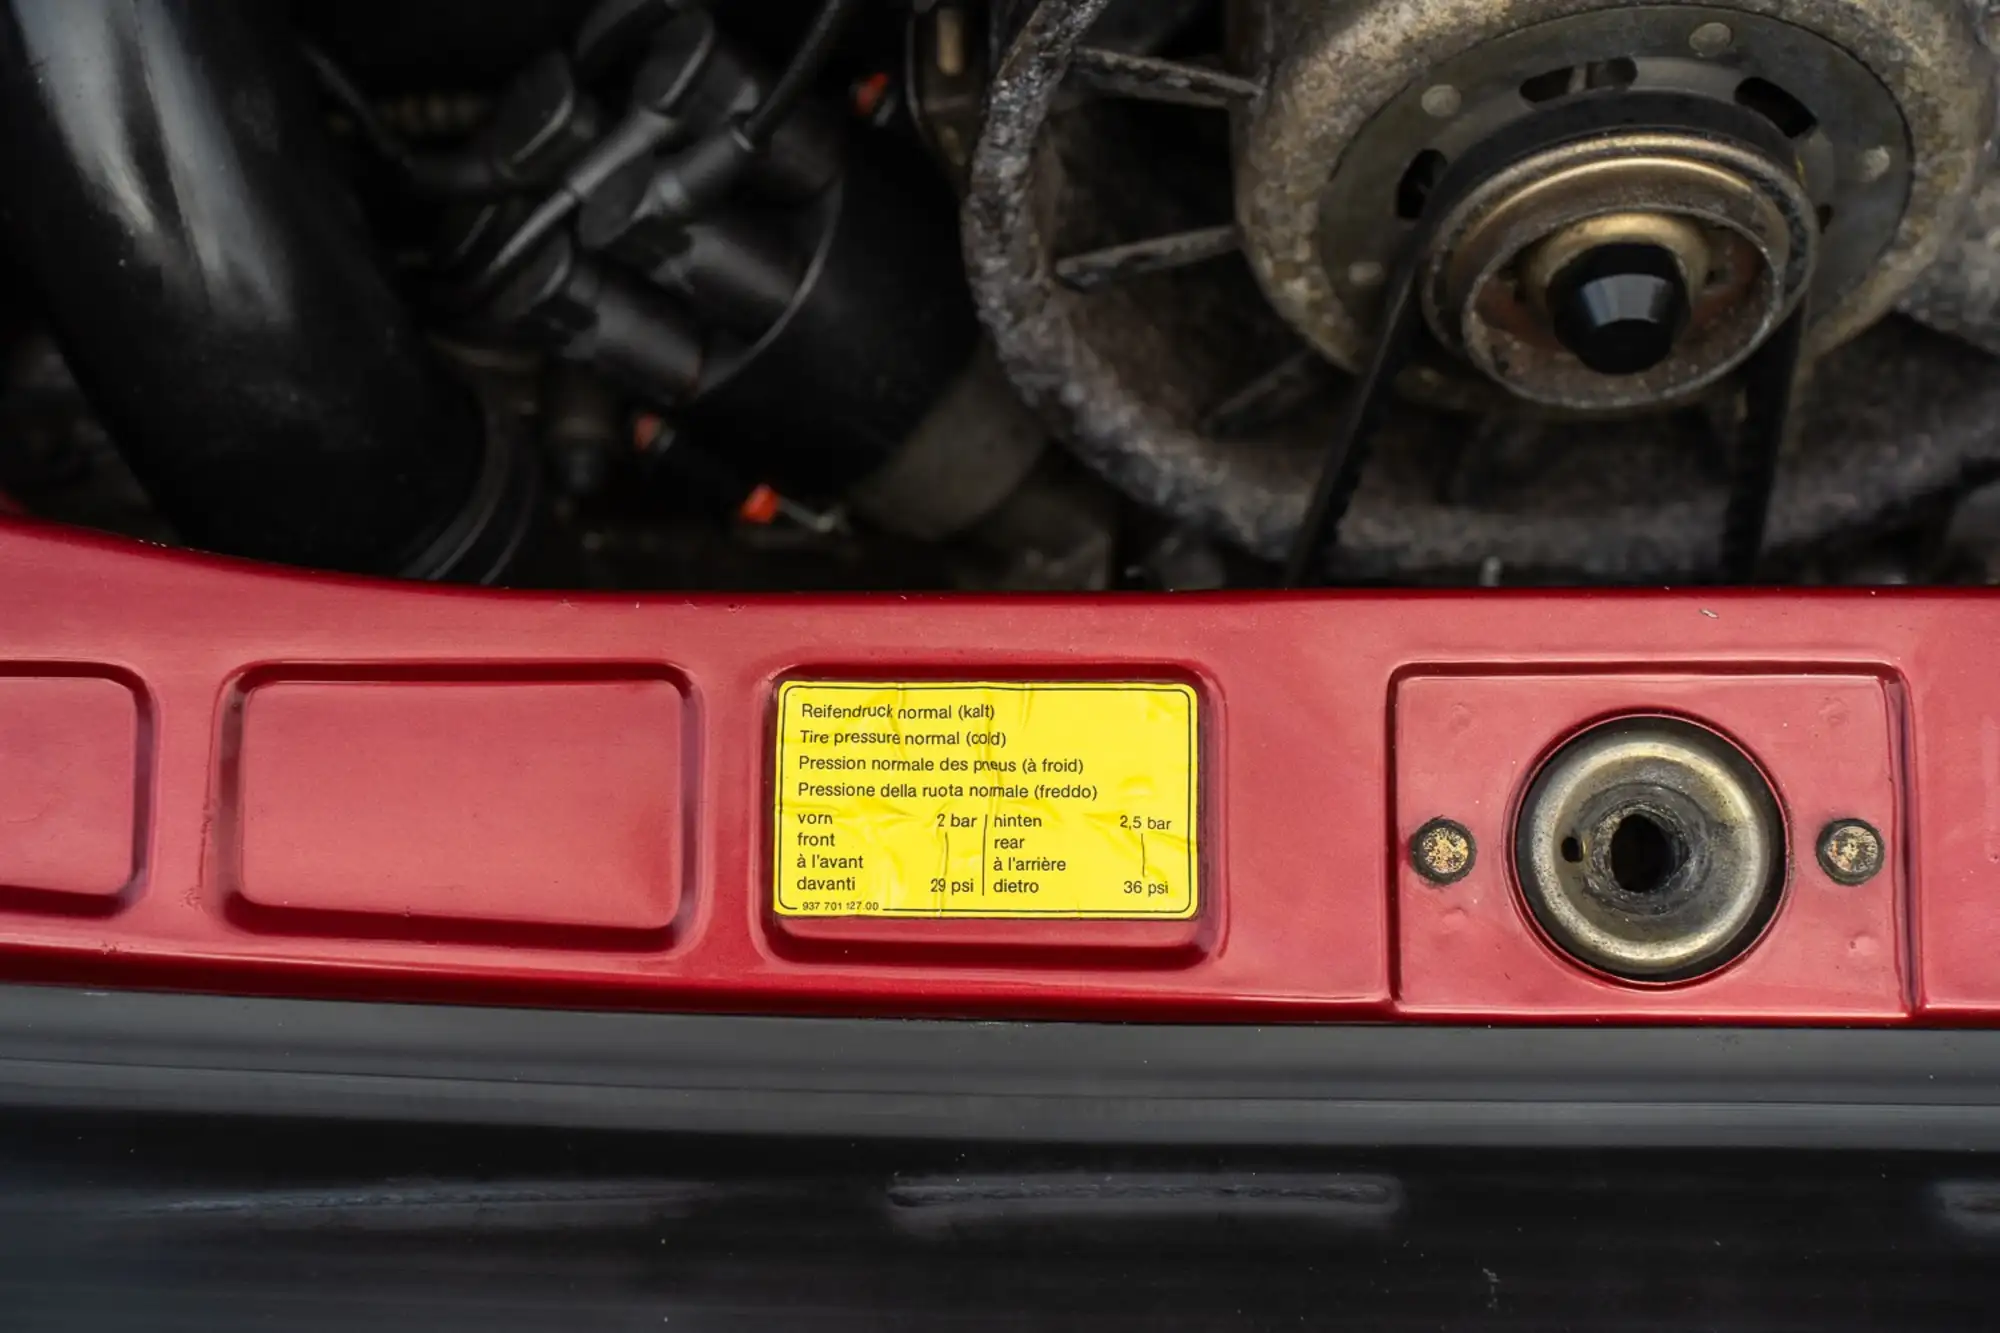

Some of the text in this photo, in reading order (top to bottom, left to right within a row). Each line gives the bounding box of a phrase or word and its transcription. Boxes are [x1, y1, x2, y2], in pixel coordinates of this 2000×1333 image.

[801, 704, 995, 720] Reifendruck normal (kalt)
[800, 730, 1007, 748] Tire pressure normal (cold)
[799, 756, 1084, 774] Pression normale des pneus (à froid)
[798, 782, 1098, 801] Pressione della ruota normale (freddo)
[798, 813, 978, 827] vorn 2 bar
[993, 813, 1172, 831] hinten 2,5 bar
[797, 833, 835, 846] front
[994, 837, 1025, 849] rear
[796, 853, 864, 869] à l'avant
[993, 856, 1066, 871] à l'arrière
[796, 877, 974, 895] davanti 29 psi
[993, 879, 1169, 897] dietro 36 psi
[802, 901, 820, 911] 937
[824, 901, 842, 911] 701
